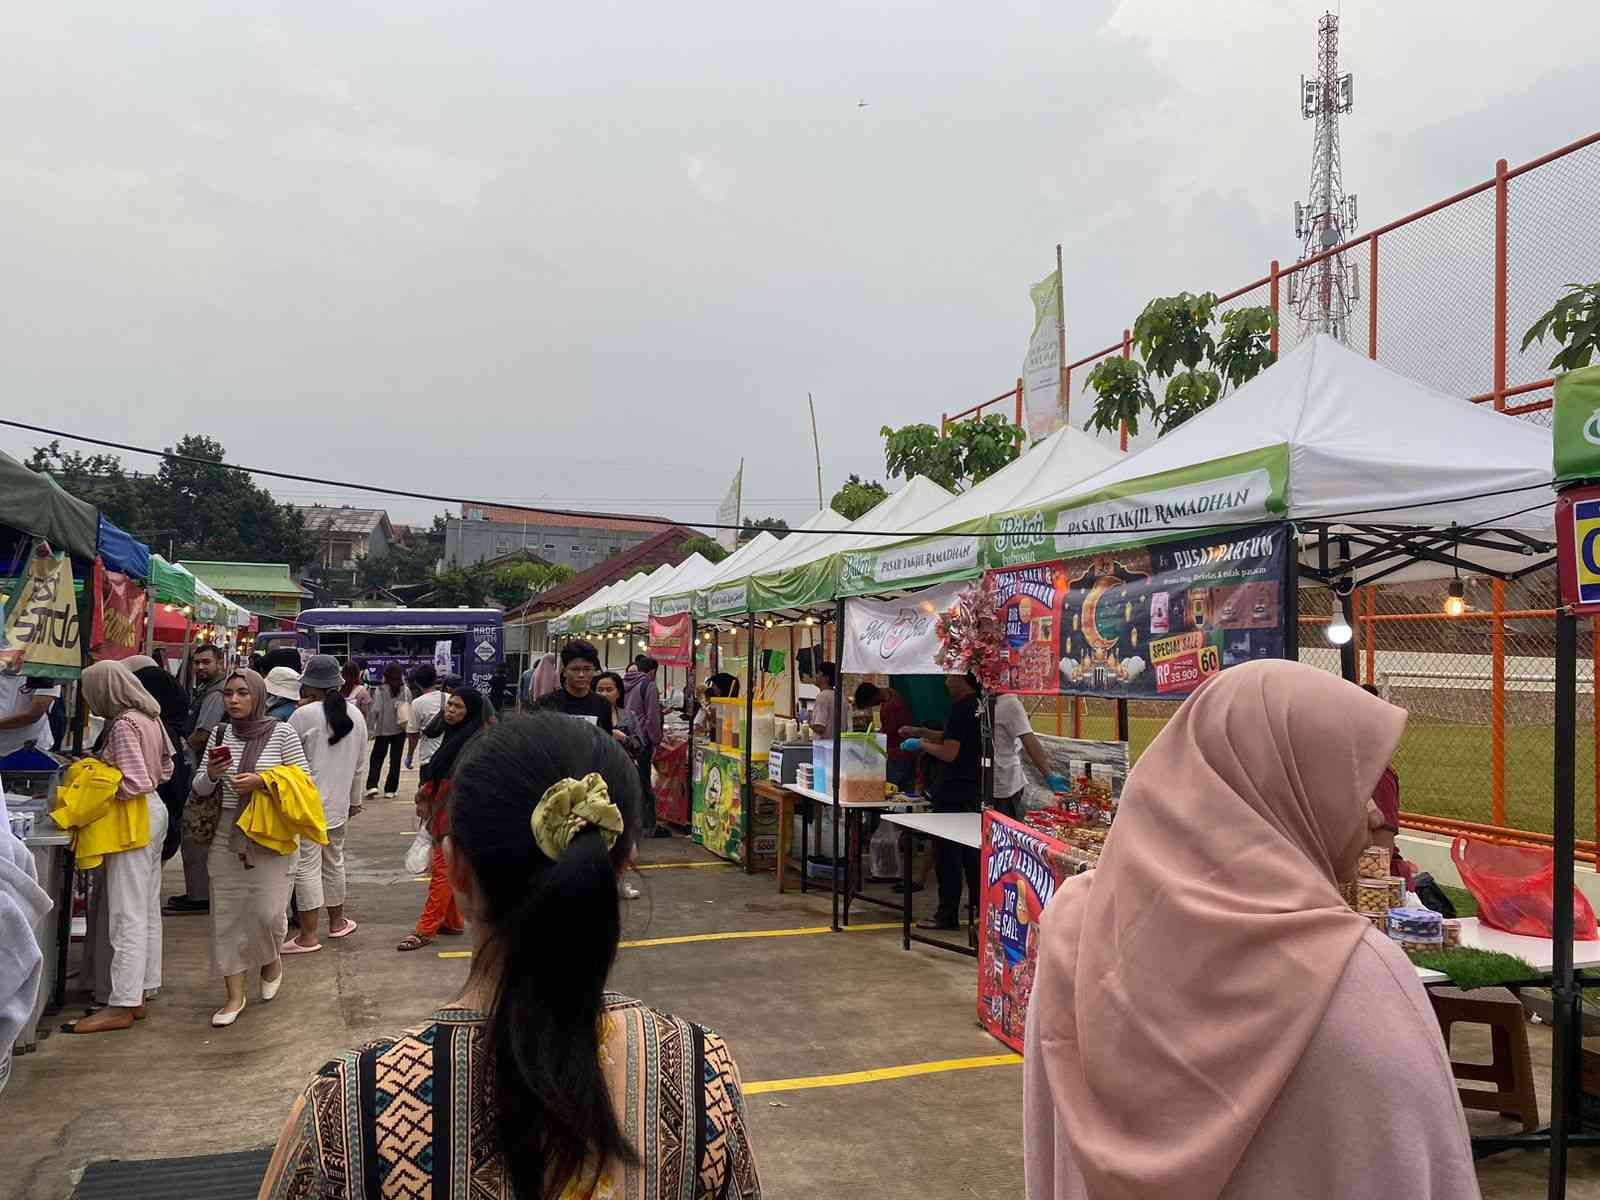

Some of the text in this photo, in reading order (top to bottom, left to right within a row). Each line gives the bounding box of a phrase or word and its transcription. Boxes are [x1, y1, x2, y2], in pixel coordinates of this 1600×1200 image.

[1068, 488, 1250, 537] PASAR TAKJIL RAMADHAN
[1174, 535, 1273, 570] PUSAT PARFUM
[1156, 663, 1170, 685] RP
[1201, 651, 1217, 673] 60
[1001, 913, 1019, 941] SALE
